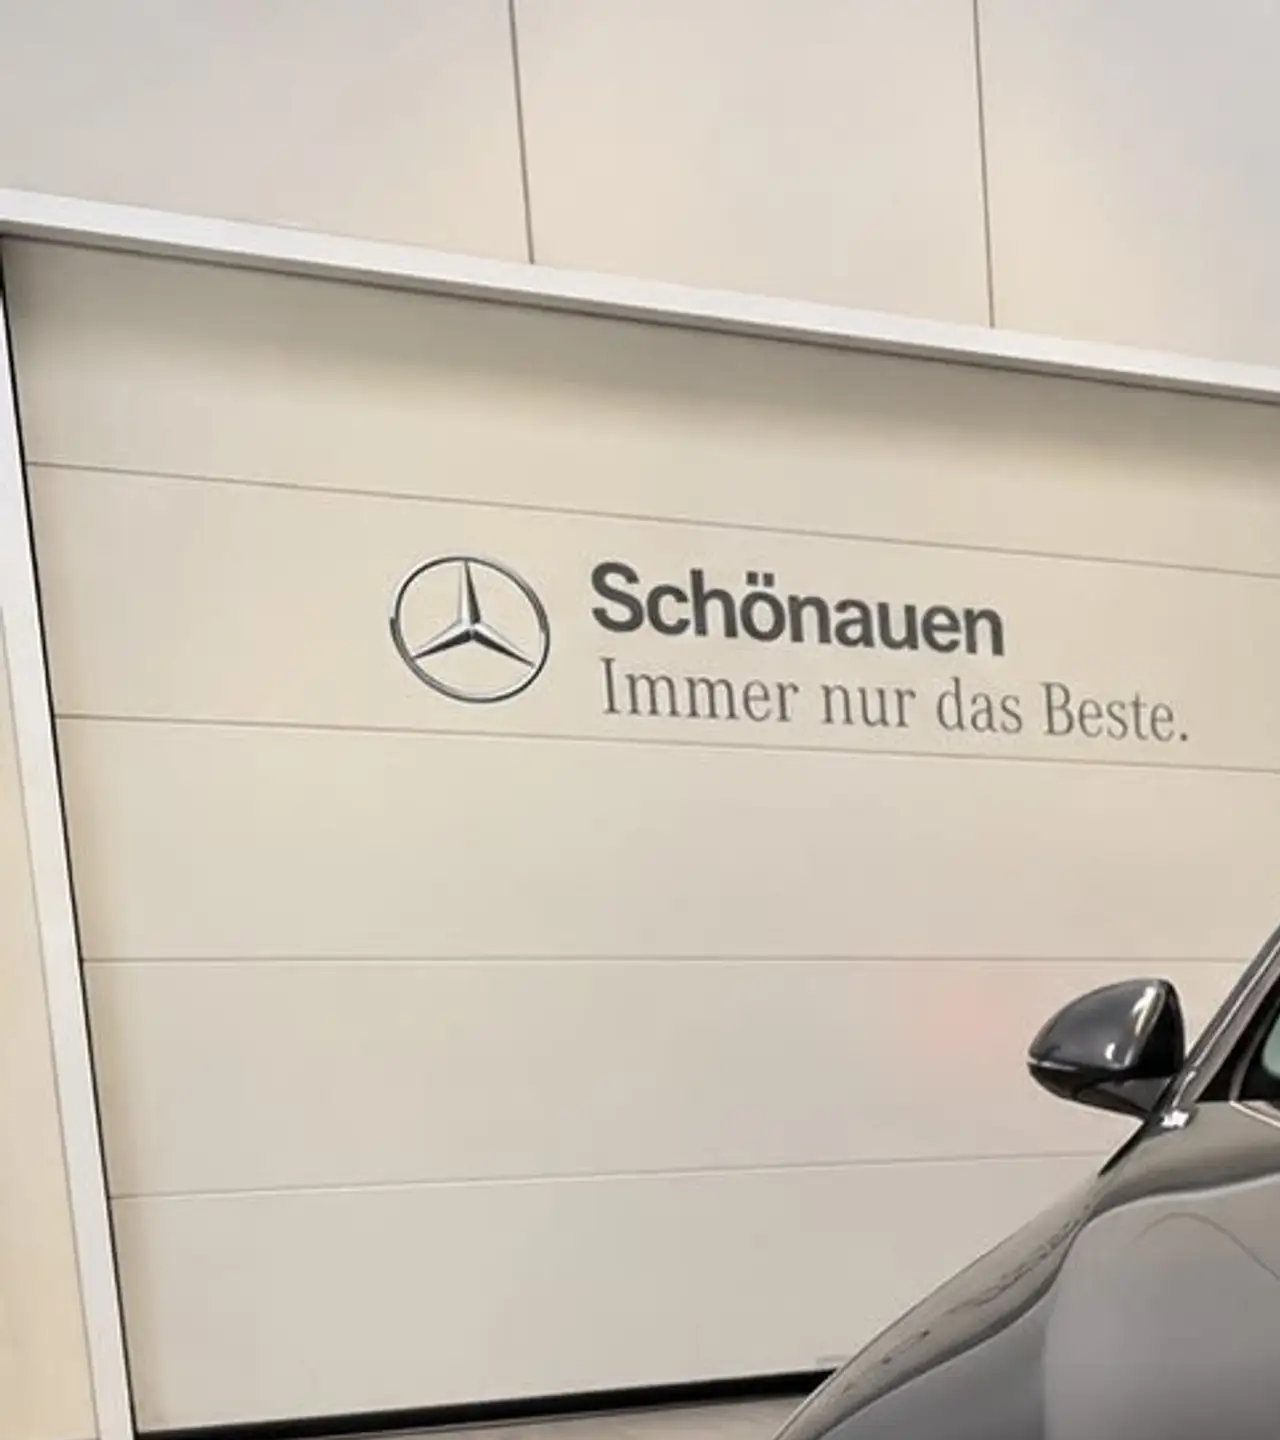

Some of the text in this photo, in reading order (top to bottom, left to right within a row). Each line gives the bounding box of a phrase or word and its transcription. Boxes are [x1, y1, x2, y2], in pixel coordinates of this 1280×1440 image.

[590, 562, 1005, 656] Schönauen
[600, 657, 1190, 742] Immer nur das Beste.
